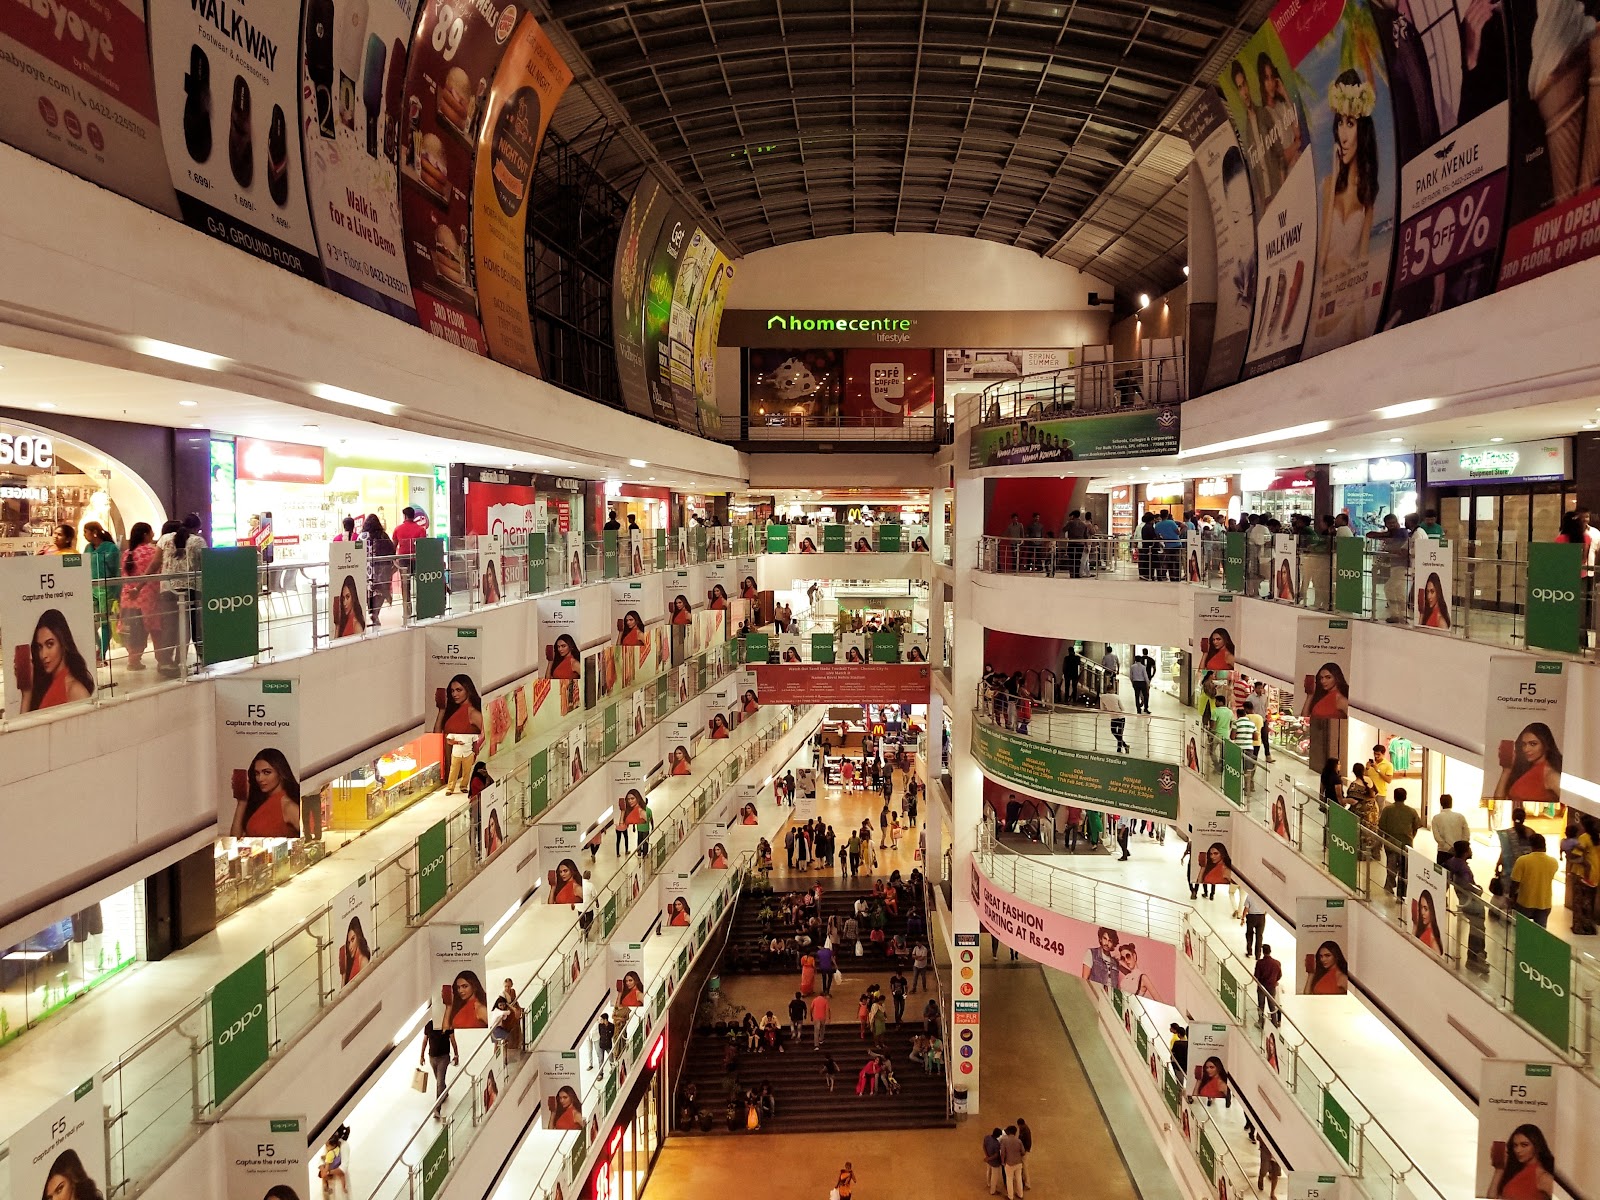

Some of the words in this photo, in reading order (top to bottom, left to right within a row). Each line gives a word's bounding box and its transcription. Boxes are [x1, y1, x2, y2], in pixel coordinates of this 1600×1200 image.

[198, 25, 228, 53] Footwear
[229, 49, 235, 59] &
[235, 54, 270, 85] Accessories
[526, 60, 536, 76] ALL
[536, 70, 550, 93] NIGHT
[499, 137, 519, 164] NIGHT
[517, 157, 529, 175] OUT
[1416, 167, 1438, 195] PARK
[1441, 144, 1479, 180] AVENUE
[346, 187, 369, 215] Walk
[369, 202, 378, 224] in
[329, 201, 345, 226] for
[347, 216, 353, 233] a
[354, 214, 372, 243] Live
[373, 228, 396, 257] Demo
[1431, 222, 1456, 250] OFF
[1532, 214, 1563, 248] NOW
[230, 227, 272, 257] GROUND
[1265, 222, 1303, 261] WALKWAY
[1555, 237, 1577, 259] OPP
[483, 256, 501, 276] HOME
[789, 315, 911, 331] homecentre
[876, 333, 910, 344] lifestyle
[530, 559, 545, 568] oppo
[1227, 556, 1243, 565] oppo
[40, 574, 55, 590] F5
[419, 571, 443, 584] oppo
[1338, 569, 1361, 579] oppo
[22, 593, 43, 602] Capture
[43, 592, 53, 600] the
[53, 591, 64, 599] real
[64, 590, 74, 599] you
[1531, 587, 1575, 604] oppo
[207, 594, 254, 614] oppo
[1210, 606, 1220, 614] F5
[553, 611, 563, 620] F5
[1318, 634, 1331, 644] F5
[447, 644, 460, 655] F5
[1519, 682, 1537, 696] F5
[1497, 695, 1523, 704] Capture
[1523, 696, 1534, 704] the
[248, 704, 266, 718] F5
[225, 720, 249, 728] Capture
[250, 719, 262, 727] the
[262, 719, 276, 727] real
[276, 720, 290, 728] you
[1226, 764, 1240, 779] oppo
[532, 773, 546, 789] oppo
[1207, 821, 1218, 829] F5
[554, 837, 565, 845] F5
[1331, 833, 1355, 855] oppo
[420, 854, 444, 877] oppo
[983, 887, 1001, 908] GREAT
[1002, 900, 1045, 932] FASHION
[1315, 913, 1328, 923] F5
[984, 902, 1014, 934] STARTING
[1015, 924, 1028, 941] AT
[1029, 930, 1065, 957] Rs.249
[450, 941, 463, 950] F5
[1519, 961, 1564, 998] oppo
[1221, 979, 1236, 999] oppo
[218, 1002, 263, 1046] oppo
[1203, 1034, 1214, 1043] F5
[554, 1063, 564, 1071] F5
[1509, 1084, 1527, 1098] F5
[1488, 1097, 1513, 1105] Capture
[51, 1116, 67, 1140] F5
[1325, 1109, 1348, 1140] oppo
[33, 1143, 54, 1165] Capture
[257, 1143, 276, 1157] F5
[235, 1159, 259, 1167] Capture
[260, 1158, 272, 1166] the
[273, 1158, 286, 1166] real
[286, 1159, 299, 1167] you
[425, 1147, 447, 1183] oppo
